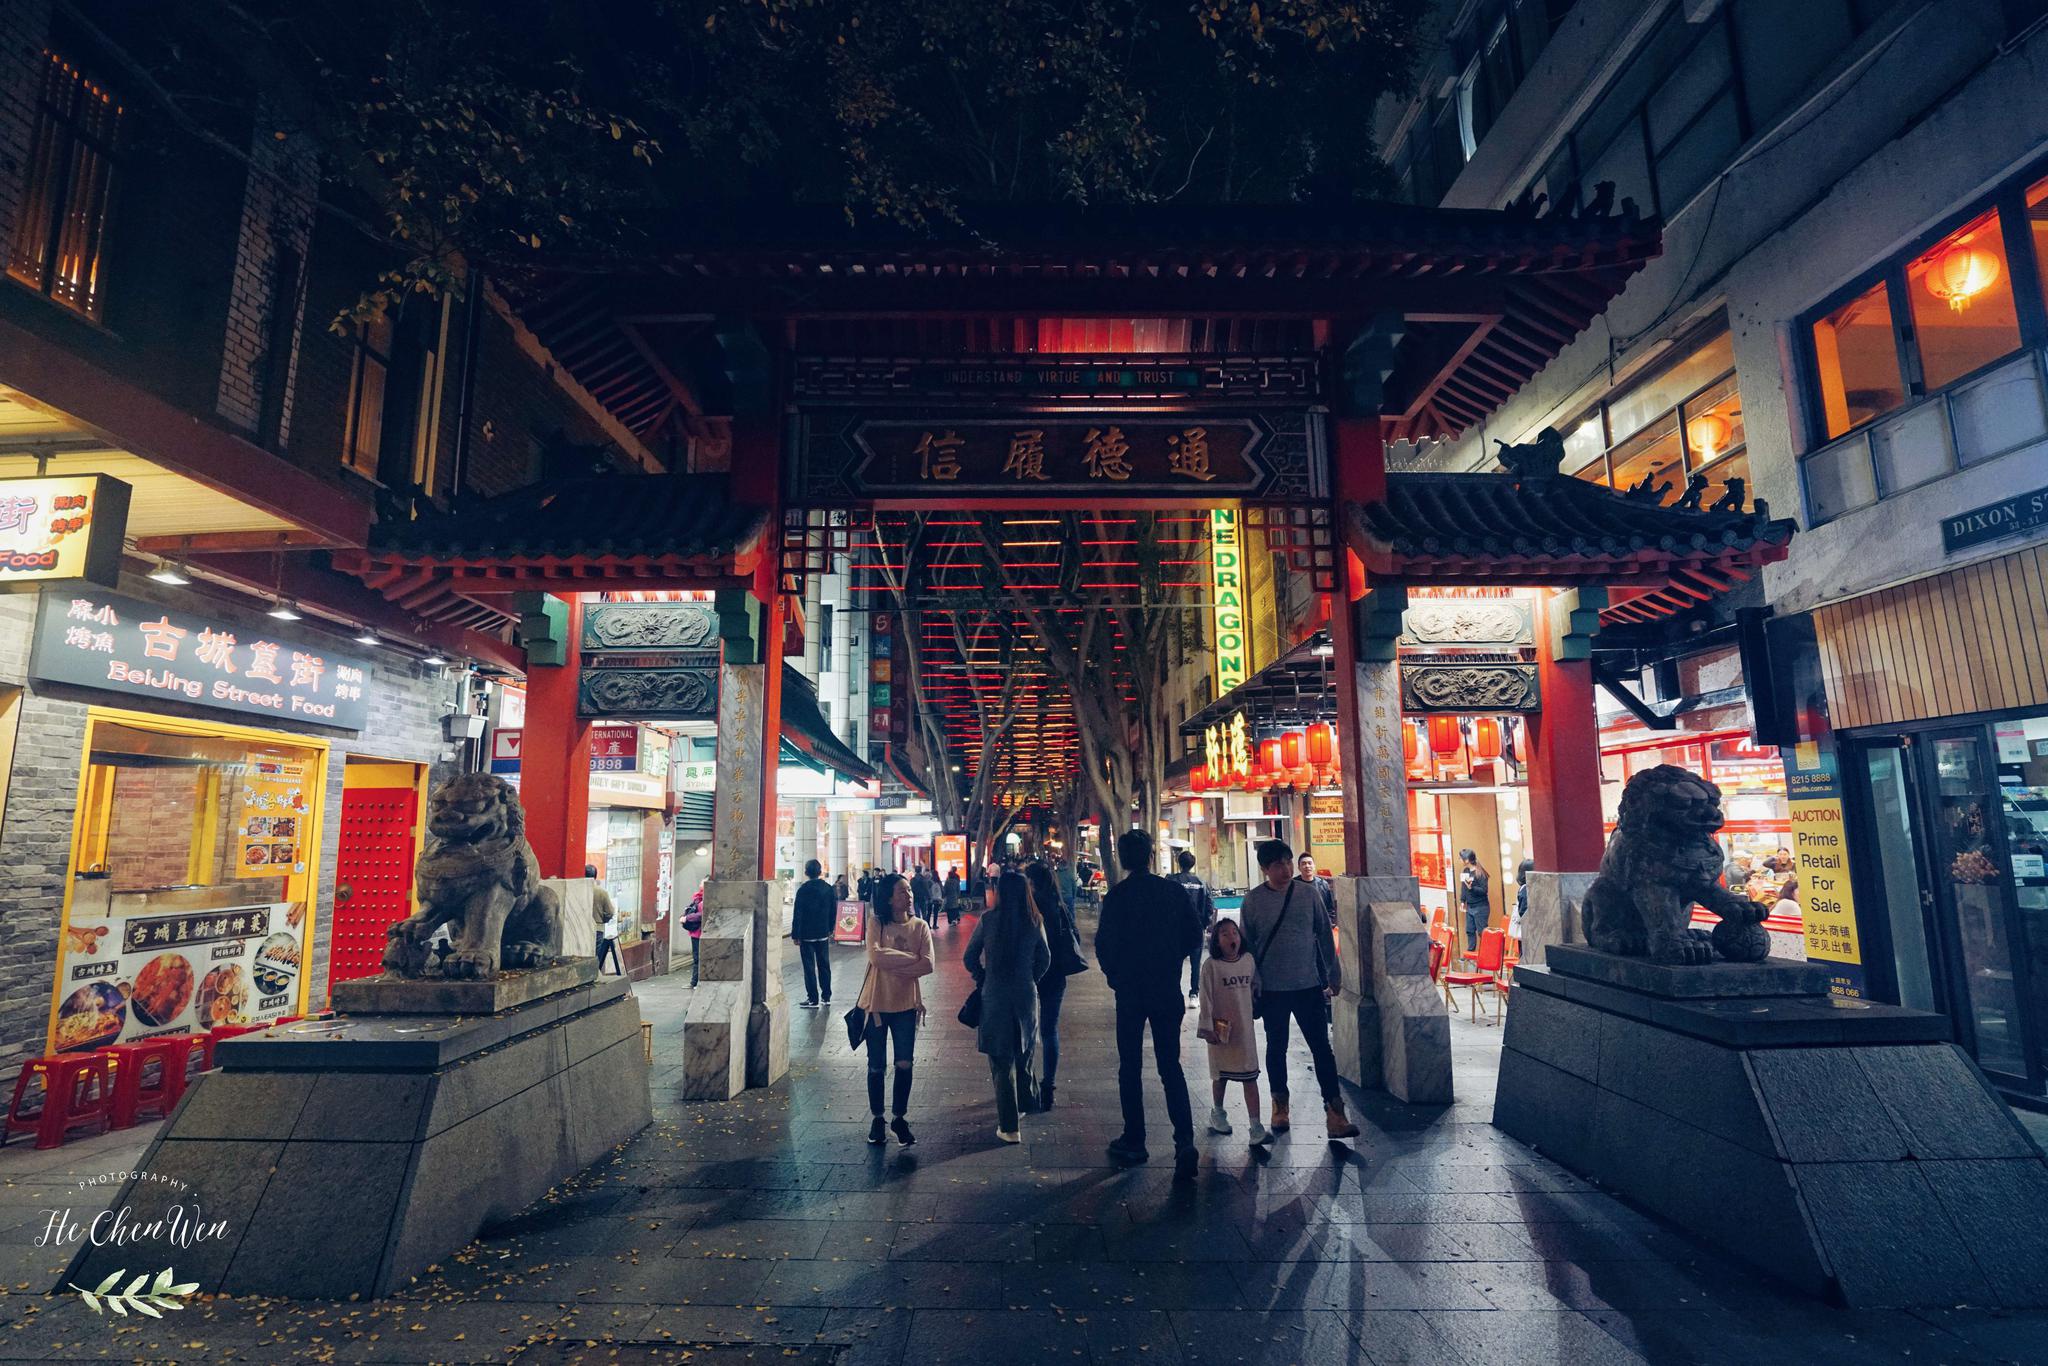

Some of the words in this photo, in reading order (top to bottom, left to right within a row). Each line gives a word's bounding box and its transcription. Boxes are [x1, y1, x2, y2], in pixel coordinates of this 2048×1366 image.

[944, 370, 1023, 384] UNDERSTAND
[1037, 371, 1080, 384] VIRTUE
[1097, 370, 1121, 384] AND
[1136, 370, 1174, 384] TRUST
[1952, 504, 2016, 537] DIXON
[212, 680, 285, 709] Street
[291, 694, 336, 718] Food
[589, 758, 623, 770] 9898
[1791, 774, 1810, 785] 8215
[1791, 809, 1841, 823] AUCTION
[1798, 832, 1839, 847] Prime
[1801, 853, 1841, 869] Retail
[1811, 876, 1835, 891] For
[1810, 896, 1841, 914] Sale
